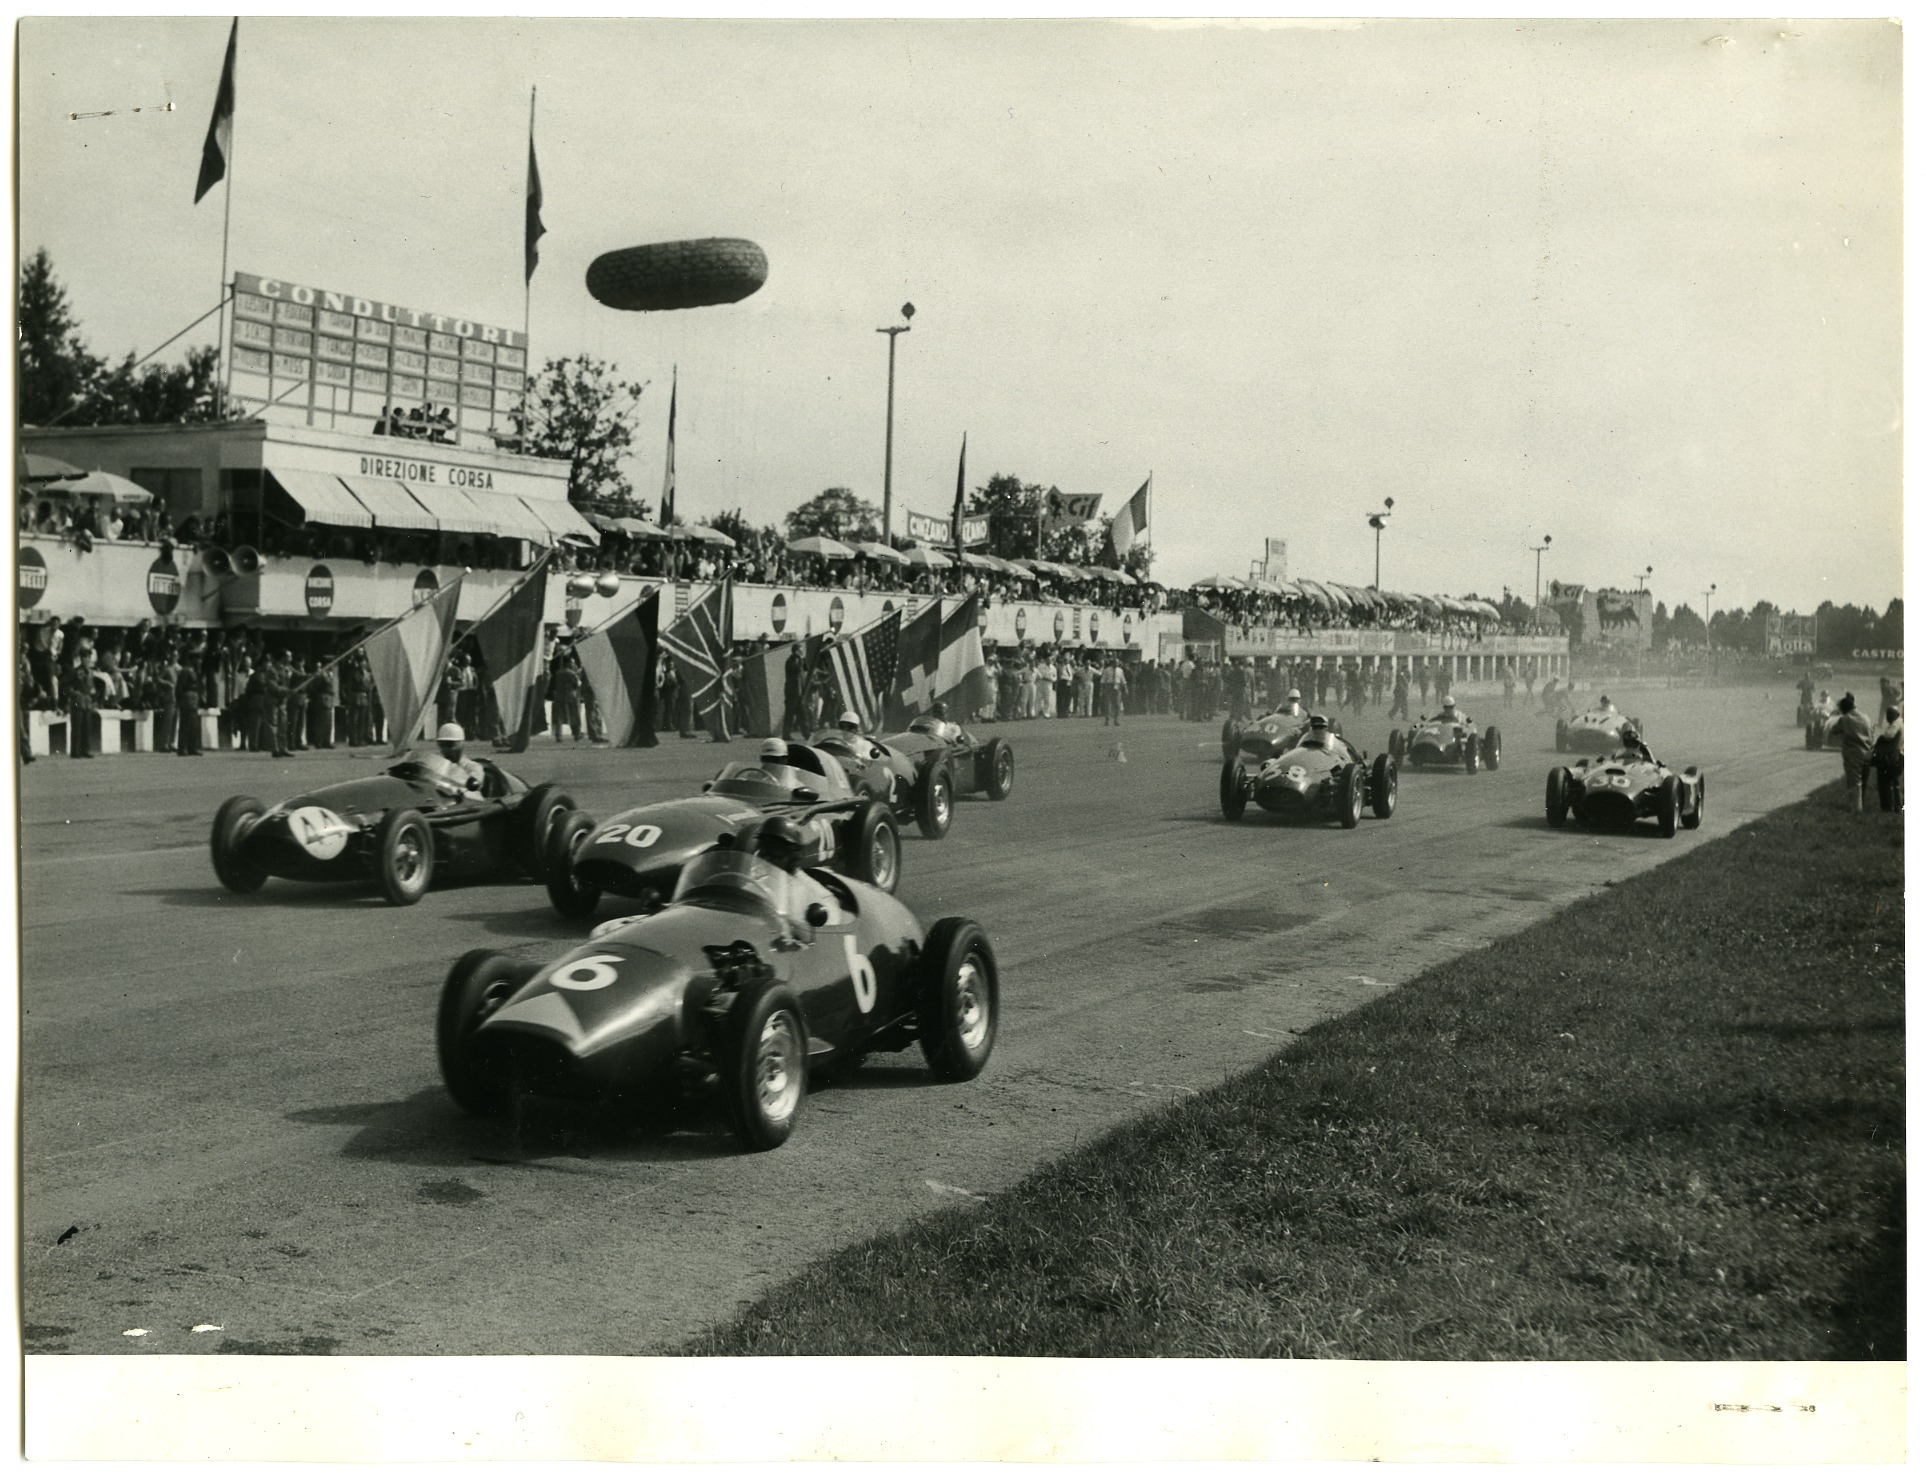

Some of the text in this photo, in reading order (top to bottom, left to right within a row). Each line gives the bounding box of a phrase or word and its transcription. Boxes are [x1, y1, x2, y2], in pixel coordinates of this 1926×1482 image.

[259, 280, 514, 346] CONDUTTORI
[361, 457, 493, 489] DIREZIONE CORSA
[910, 516, 948, 543] CINZANO
[962, 520, 988, 543] ZANO
[1852, 648, 1905, 659] CASTRO
[595, 823, 663, 848] 20
[549, 954, 627, 991] 6
[843, 934, 878, 1014] 6
